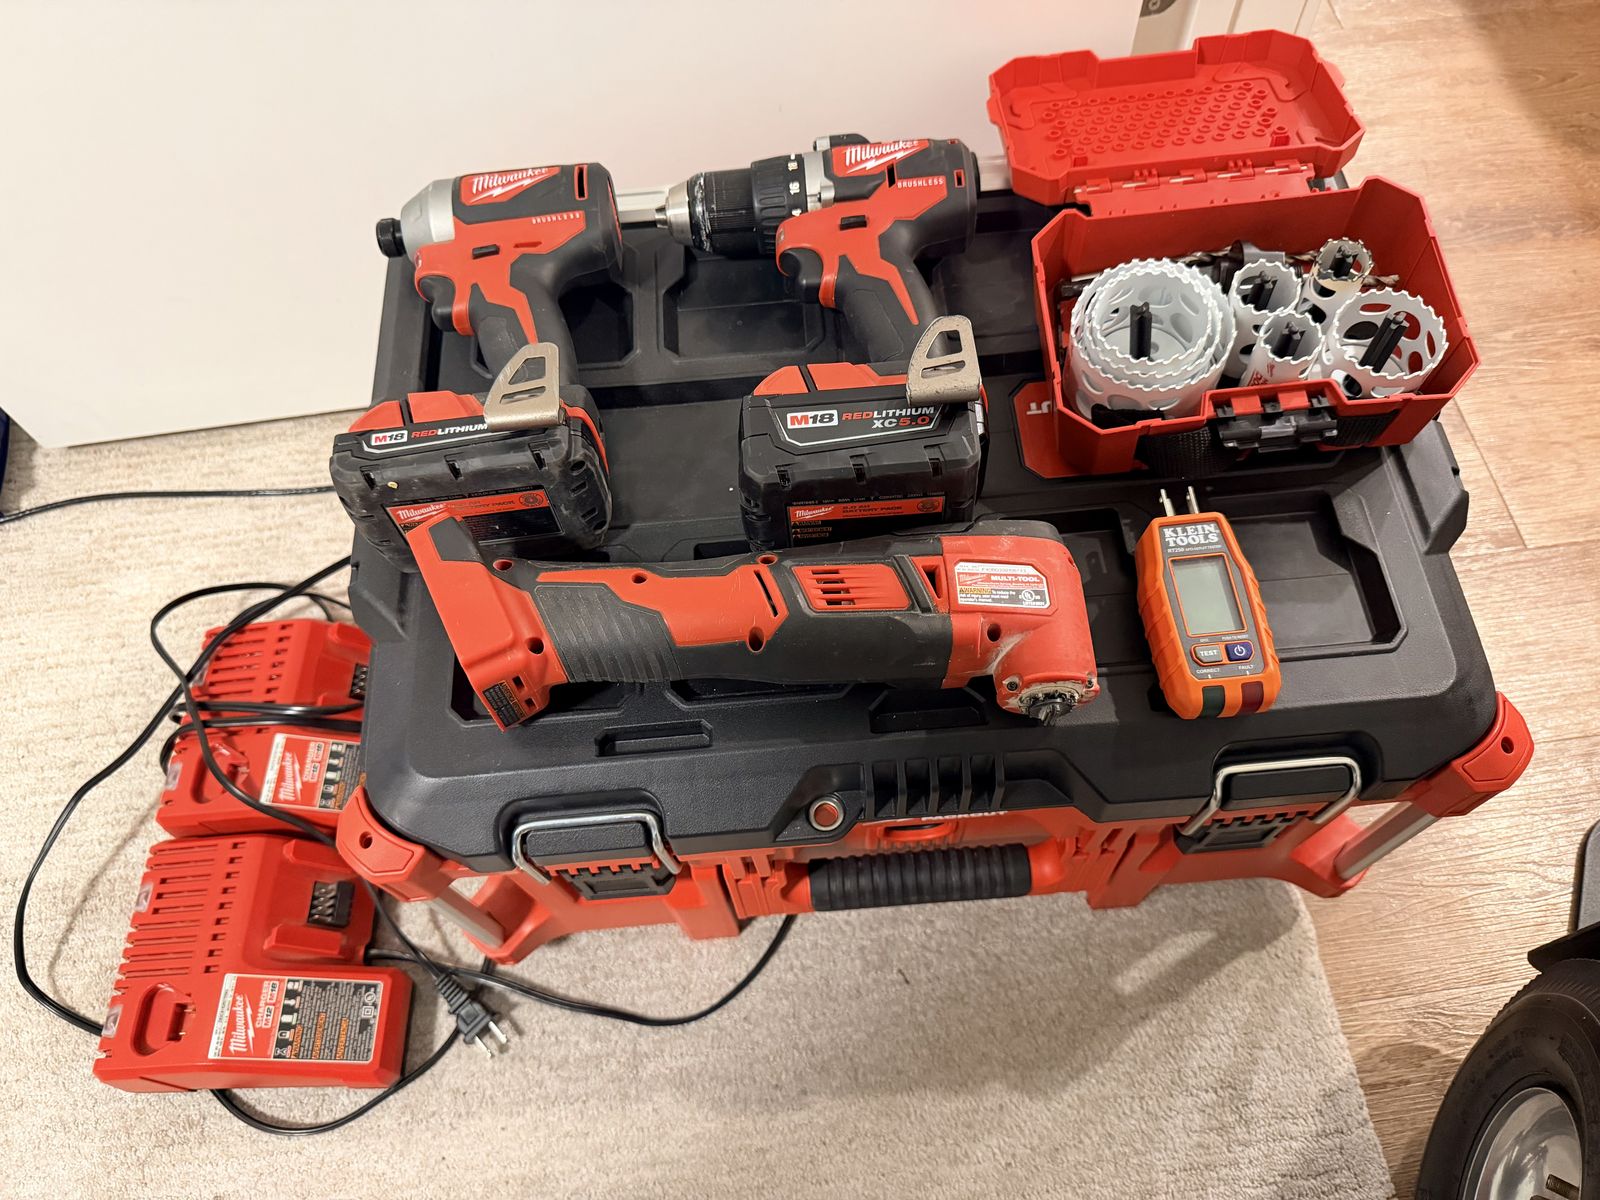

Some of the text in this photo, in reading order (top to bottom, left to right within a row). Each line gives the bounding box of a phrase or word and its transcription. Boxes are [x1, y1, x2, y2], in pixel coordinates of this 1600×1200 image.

[844, 140, 918, 167] Milwaukee
[472, 168, 549, 194] Milwaukee
[789, 181, 800, 195] 16
[897, 179, 944, 188] BRUSHLESS
[532, 212, 580, 224] BRUSHLESS
[790, 407, 935, 426] M18 REDLITHIUM
[374, 424, 488, 444] M18 REDLITHIUM
[397, 503, 446, 520] Milwaukee
[795, 506, 834, 518] Milwaukee
[1163, 524, 1217, 537] KLEIN
[1165, 533, 1219, 547] TOOLS
[1200, 649, 1218, 657] TEST
[279, 751, 296, 801] Milwaukee
[256, 981, 270, 1028] CHARGER
[263, 982, 278, 1026] M12 M18
[229, 993, 248, 1054] Milwaukee
